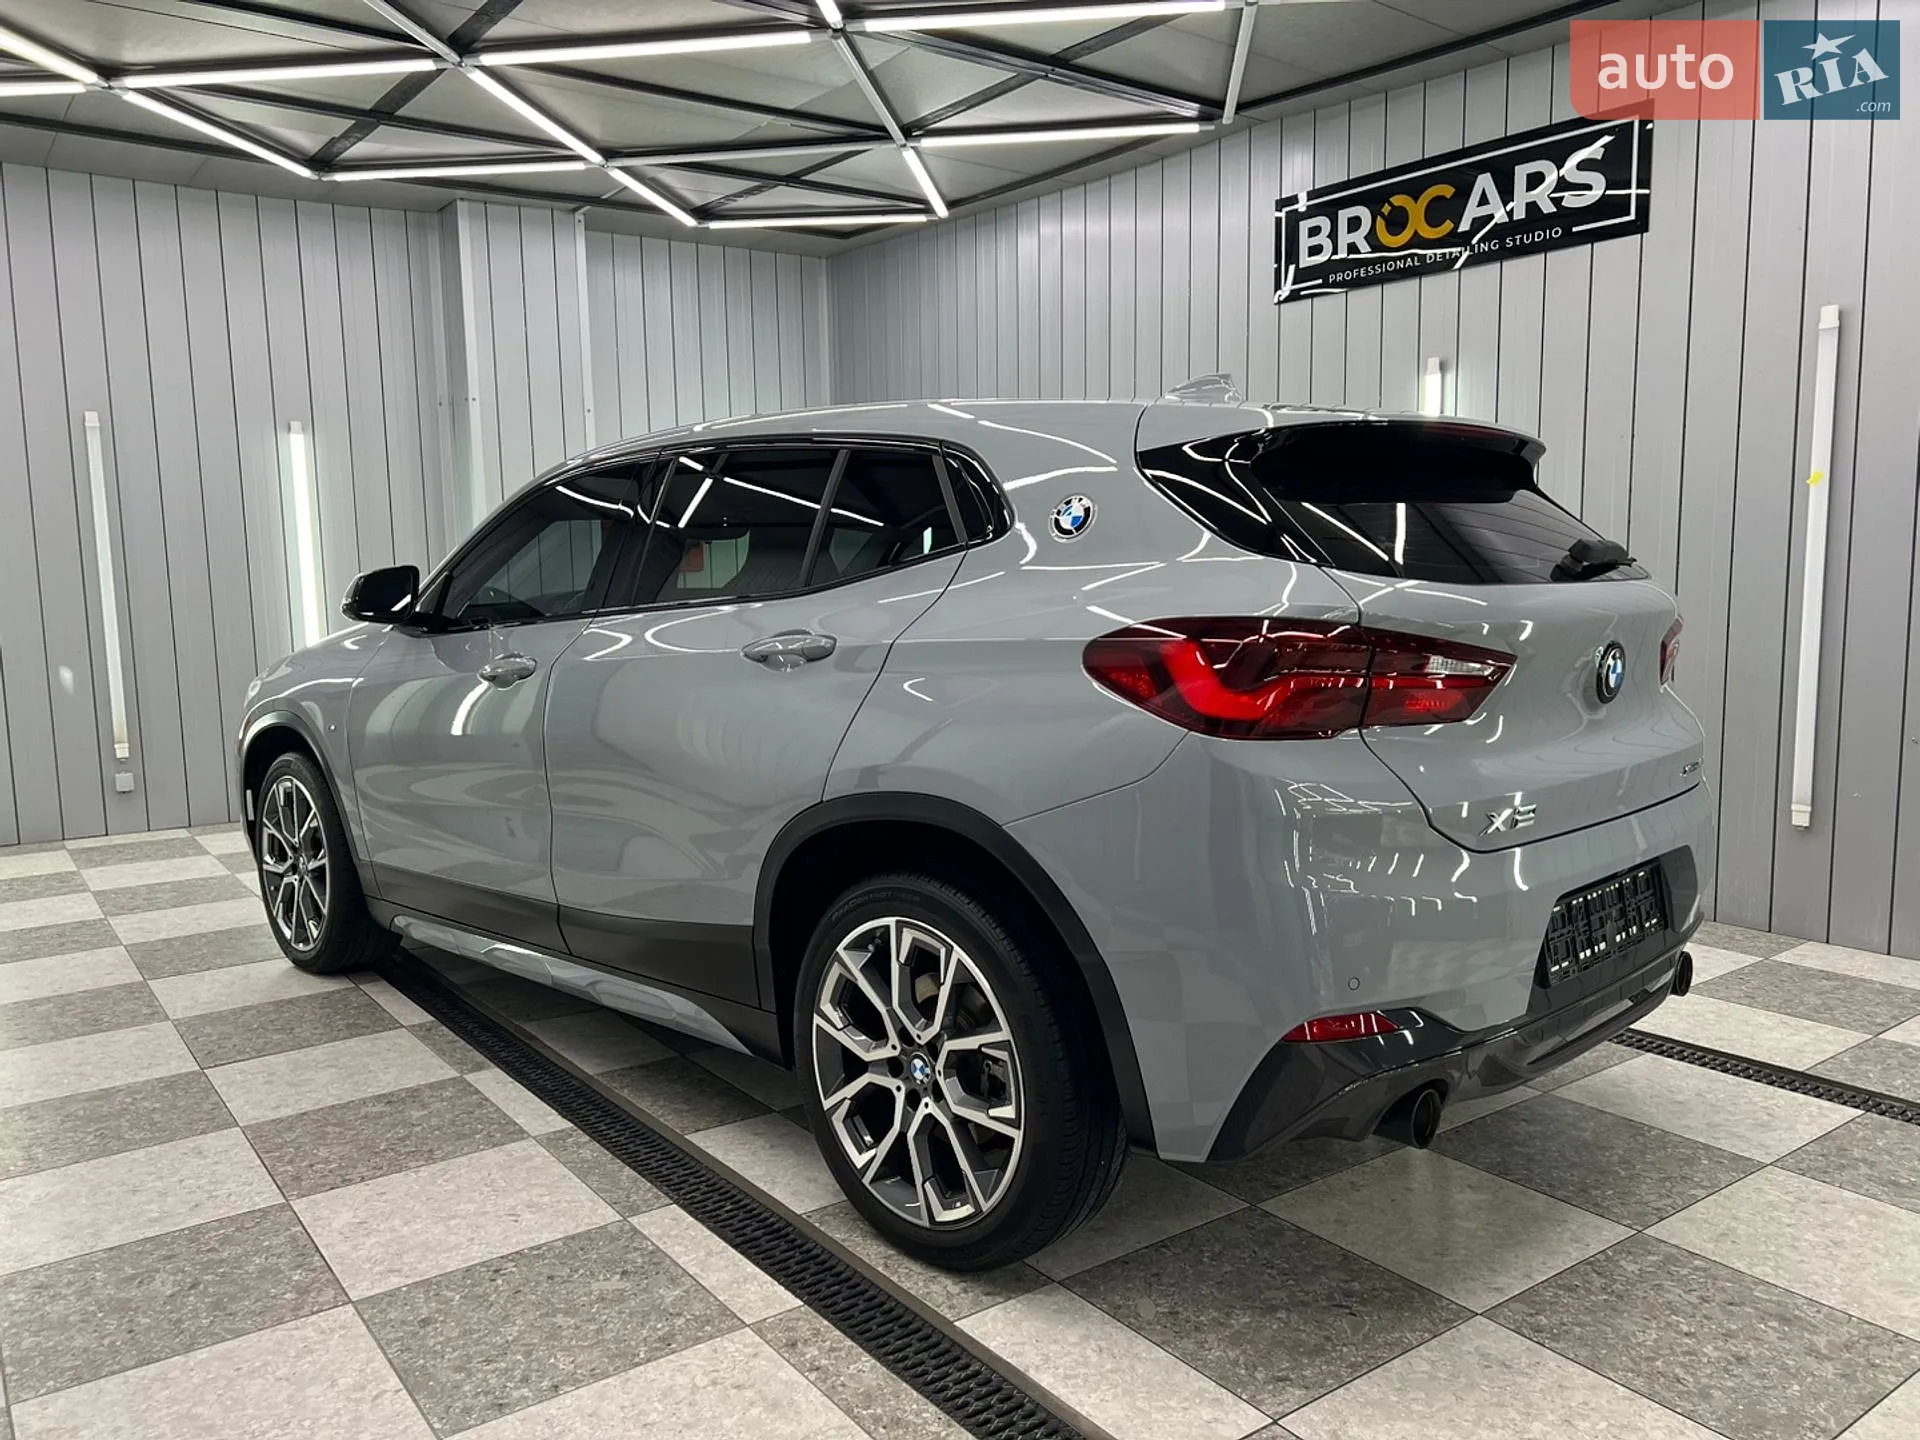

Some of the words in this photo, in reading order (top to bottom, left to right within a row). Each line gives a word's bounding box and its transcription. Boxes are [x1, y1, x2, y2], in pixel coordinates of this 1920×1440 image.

[1299, 146, 1607, 269] BROCARS
[1329, 257, 1421, 284] PROFESSIONAL
[1426, 240, 1500, 264] DETAILING
[1505, 227, 1562, 247] STUDIO
